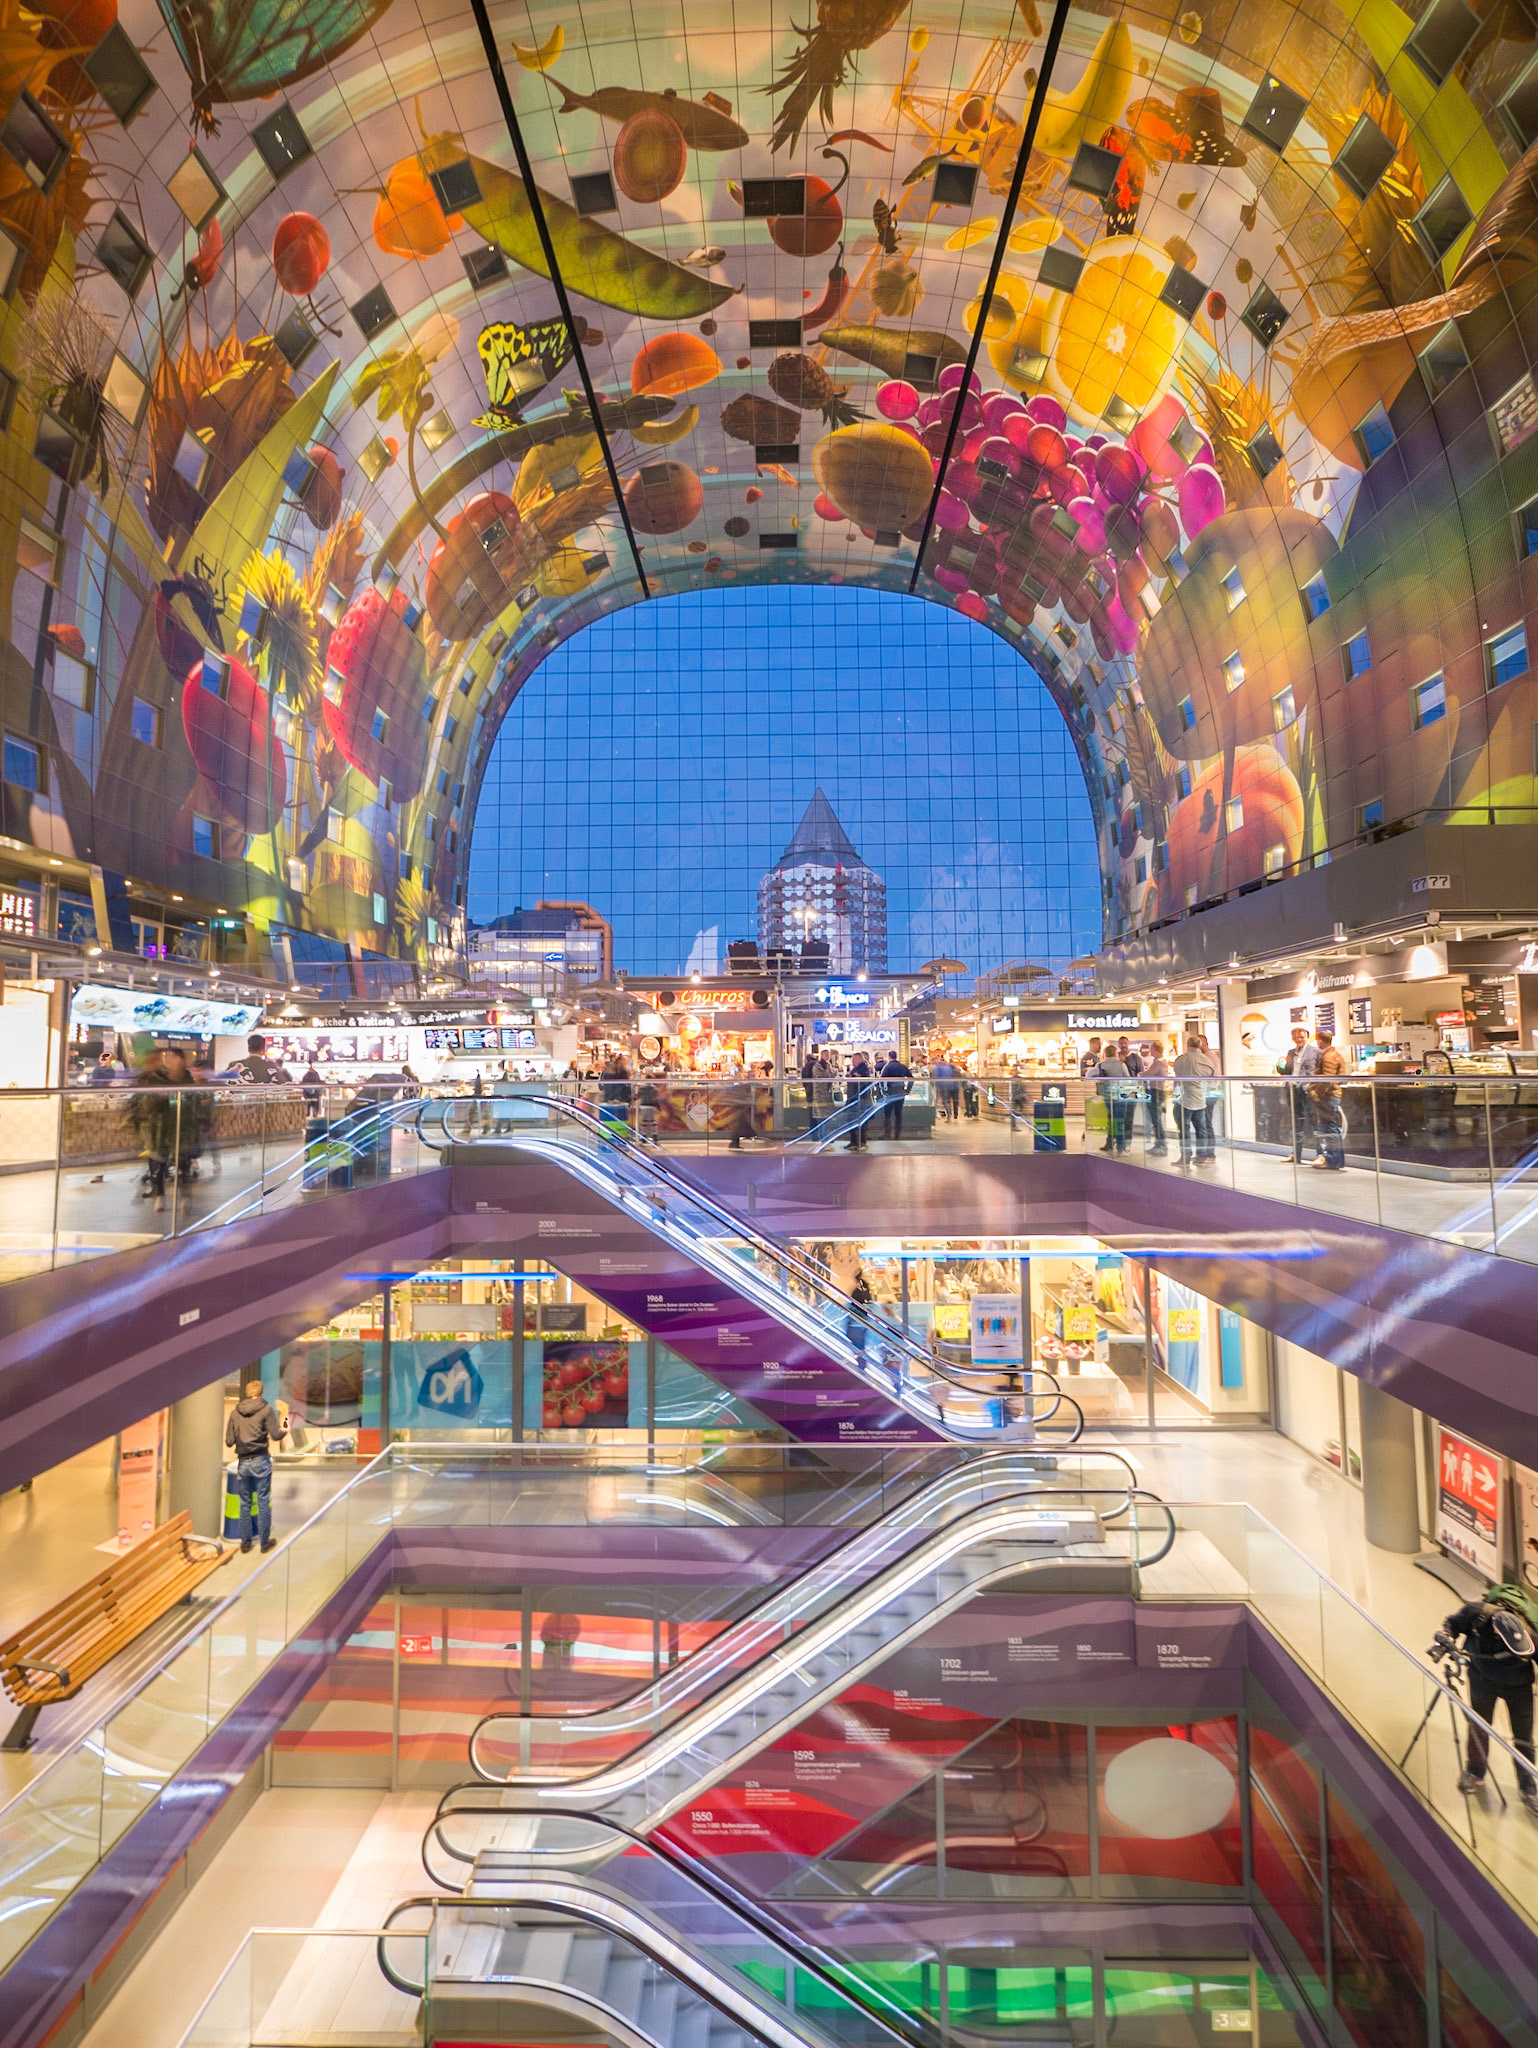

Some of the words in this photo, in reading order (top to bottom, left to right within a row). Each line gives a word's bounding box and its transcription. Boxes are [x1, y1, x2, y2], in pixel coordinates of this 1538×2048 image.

[1413, 878, 1427, 890] 77
[1430, 876, 1448, 887] 77
[617, 969, 628, 977] 49
[680, 989, 746, 1003] Churros
[312, 1016, 347, 1027] Butcher
[347, 1016, 357, 1027] &
[358, 1016, 396, 1027] Trattoria
[845, 1020, 861, 1031] DE
[1067, 1013, 1140, 1028] Leonidas
[538, 1220, 556, 1228] 2000
[647, 1294, 664, 1303] 1968
[763, 1361, 780, 1370] 1920
[838, 1422, 855, 1430] 1876
[401, 1639, 414, 1652] -2
[1157, 1644, 1180, 1655] 1870
[940, 1658, 962, 1669] 1702
[793, 1750, 816, 1761] 1595
[691, 1811, 713, 1822] 1550
[1214, 2012, 1229, 2028] -3
